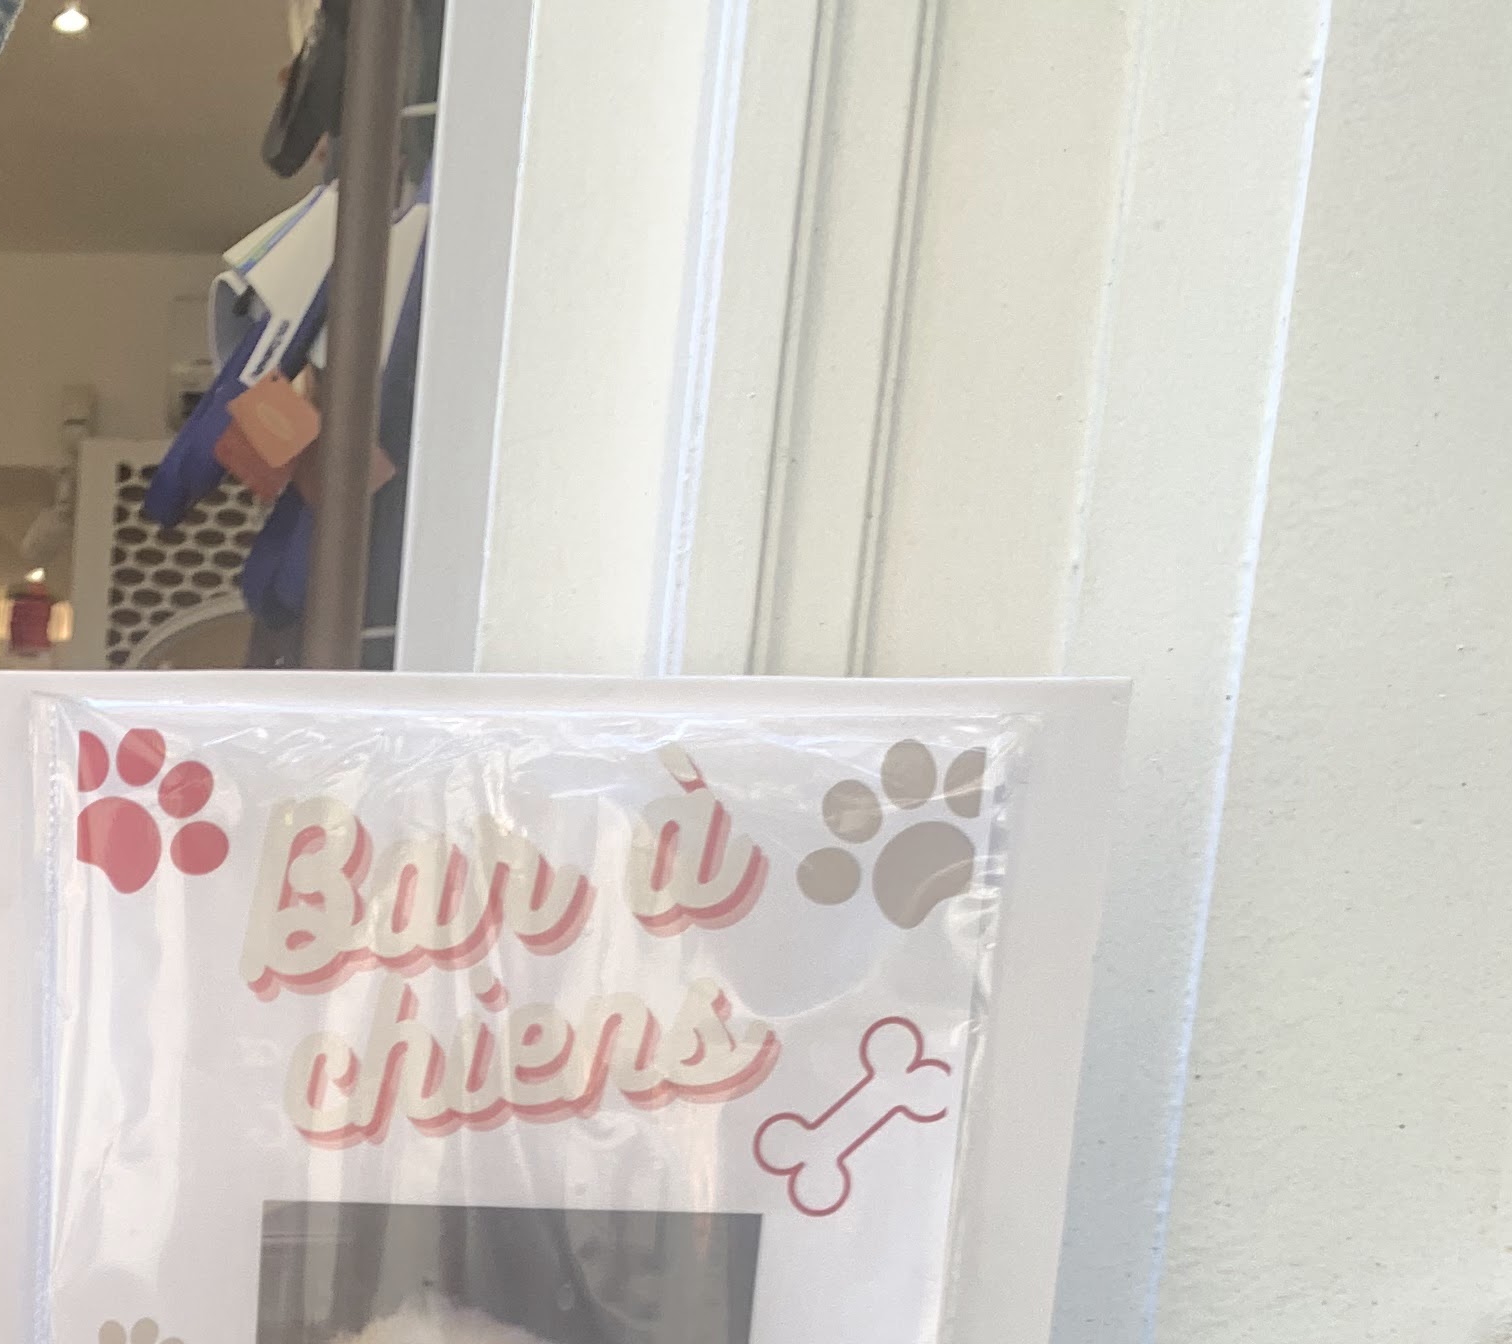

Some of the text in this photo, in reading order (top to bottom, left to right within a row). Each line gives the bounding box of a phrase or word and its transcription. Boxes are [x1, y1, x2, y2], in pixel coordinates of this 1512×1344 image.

[239, 743, 770, 1002] Bar à
[283, 972, 782, 1149] chiens
